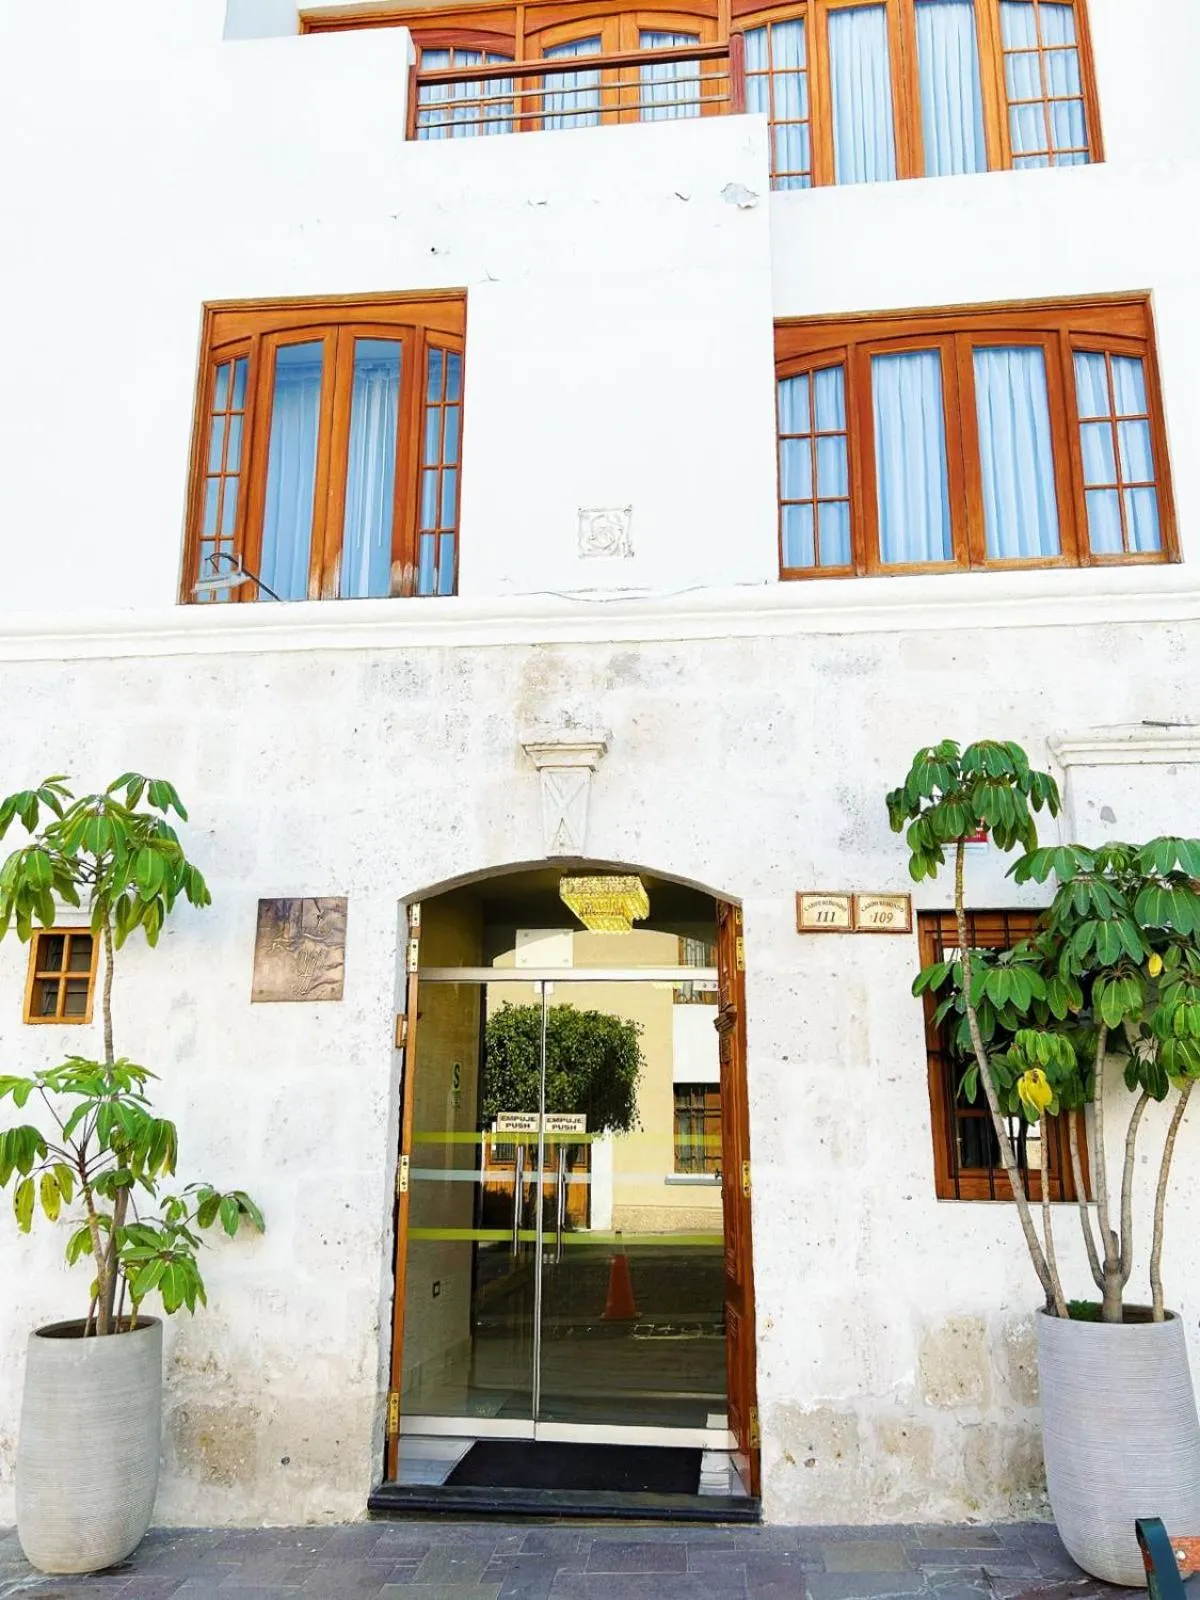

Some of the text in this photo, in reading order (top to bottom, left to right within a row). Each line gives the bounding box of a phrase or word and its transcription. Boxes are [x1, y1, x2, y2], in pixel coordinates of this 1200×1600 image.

[816, 911, 836, 922] 111
[873, 911, 894, 923] 109
[453, 1063, 461, 1089] S
